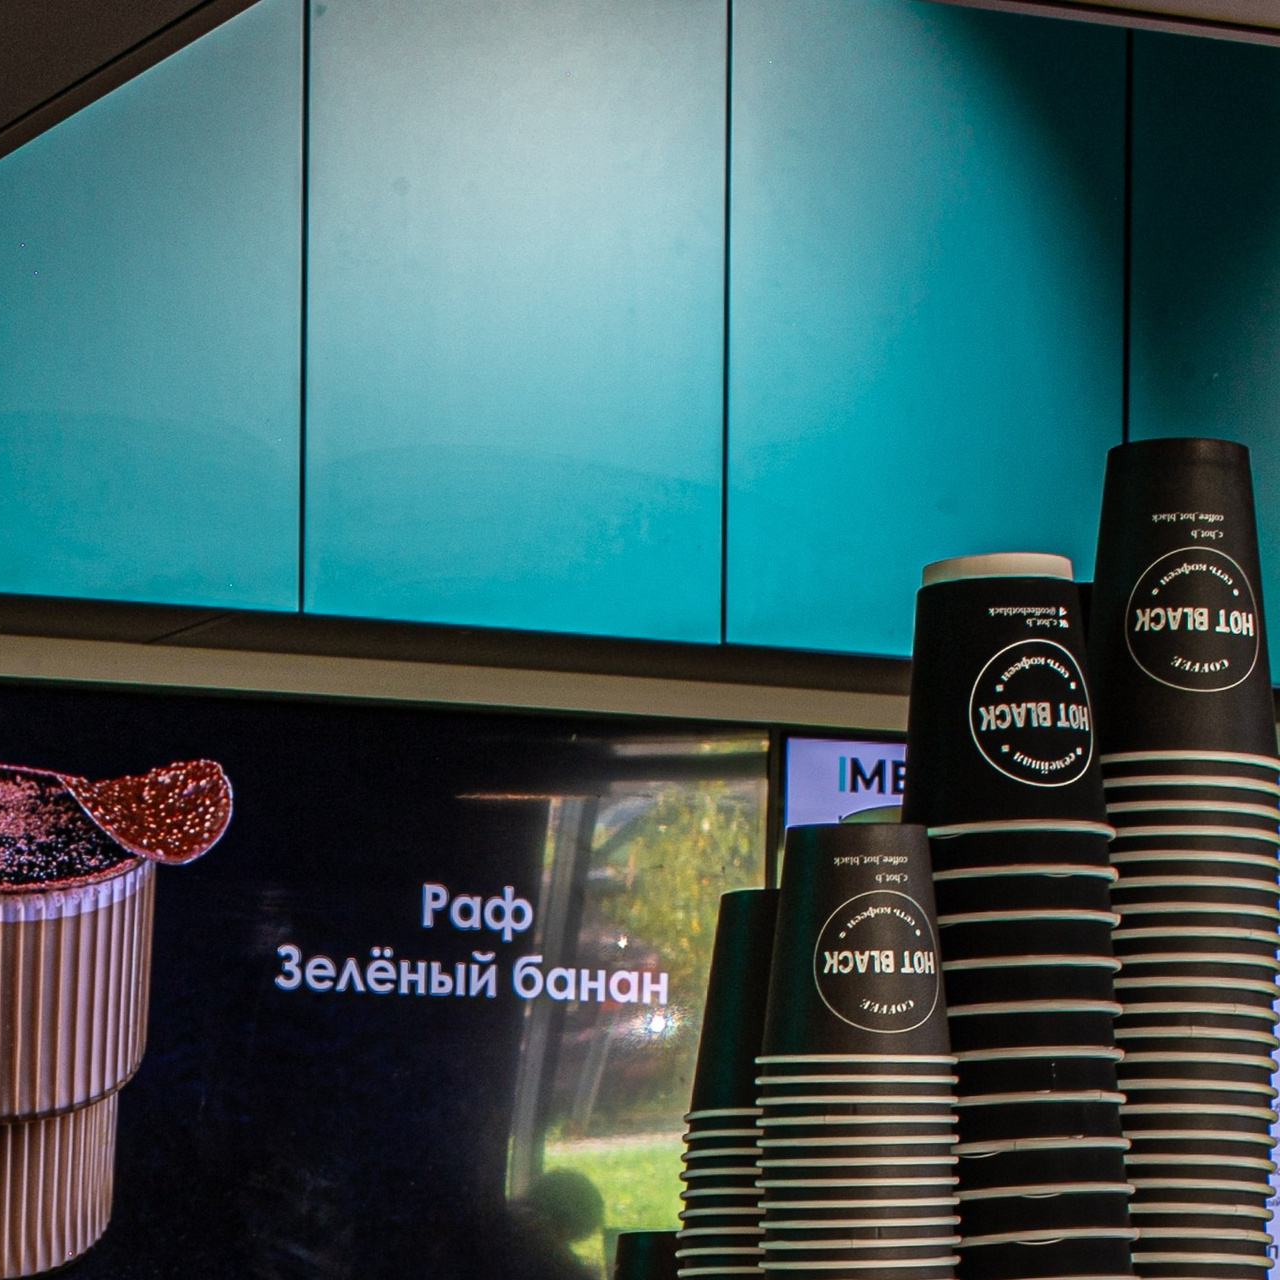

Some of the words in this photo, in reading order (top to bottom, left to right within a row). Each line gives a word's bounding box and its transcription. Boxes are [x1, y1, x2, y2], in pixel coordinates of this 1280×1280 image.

[1134, 606, 1210, 632] BLACK
[1215, 608, 1255, 637] HOT
[1170, 654, 1230, 674] COFFEE
[979, 701, 1052, 732] BLACK
[1057, 702, 1090, 732] HOT
[422, 881, 535, 944] Раф
[274, 944, 498, 999] Зелёный
[513, 953, 669, 1006] банан
[823, 949, 896, 975] BLACK
[900, 950, 936, 975] HOT
[858, 997, 915, 1015] COFFEE
